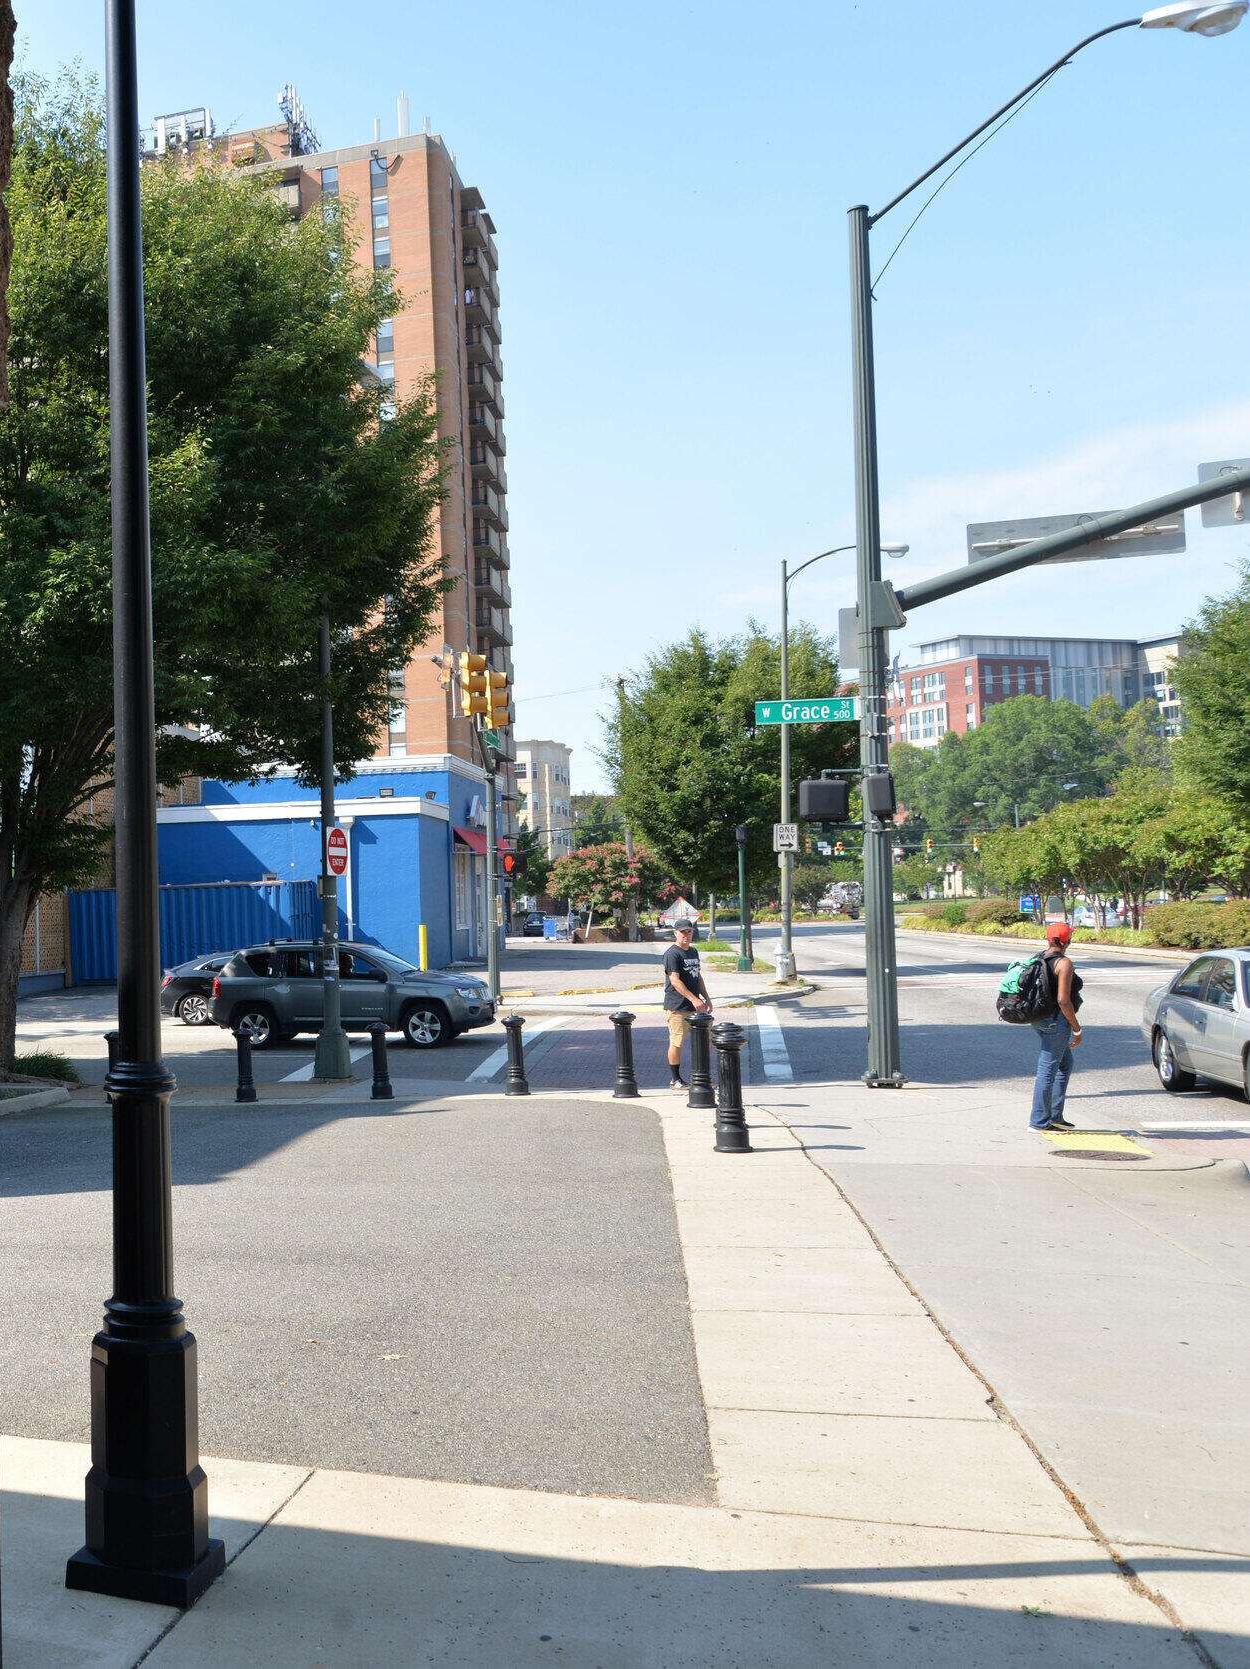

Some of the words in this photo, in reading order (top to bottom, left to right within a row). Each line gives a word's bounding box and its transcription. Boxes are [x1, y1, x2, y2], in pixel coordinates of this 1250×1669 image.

[762, 707, 771, 718] W
[781, 703, 830, 721] Grace
[840, 700, 850, 709] St
[833, 709, 851, 719] 500
[330, 836, 336, 844] DO
[332, 858, 344, 866] ENTER
